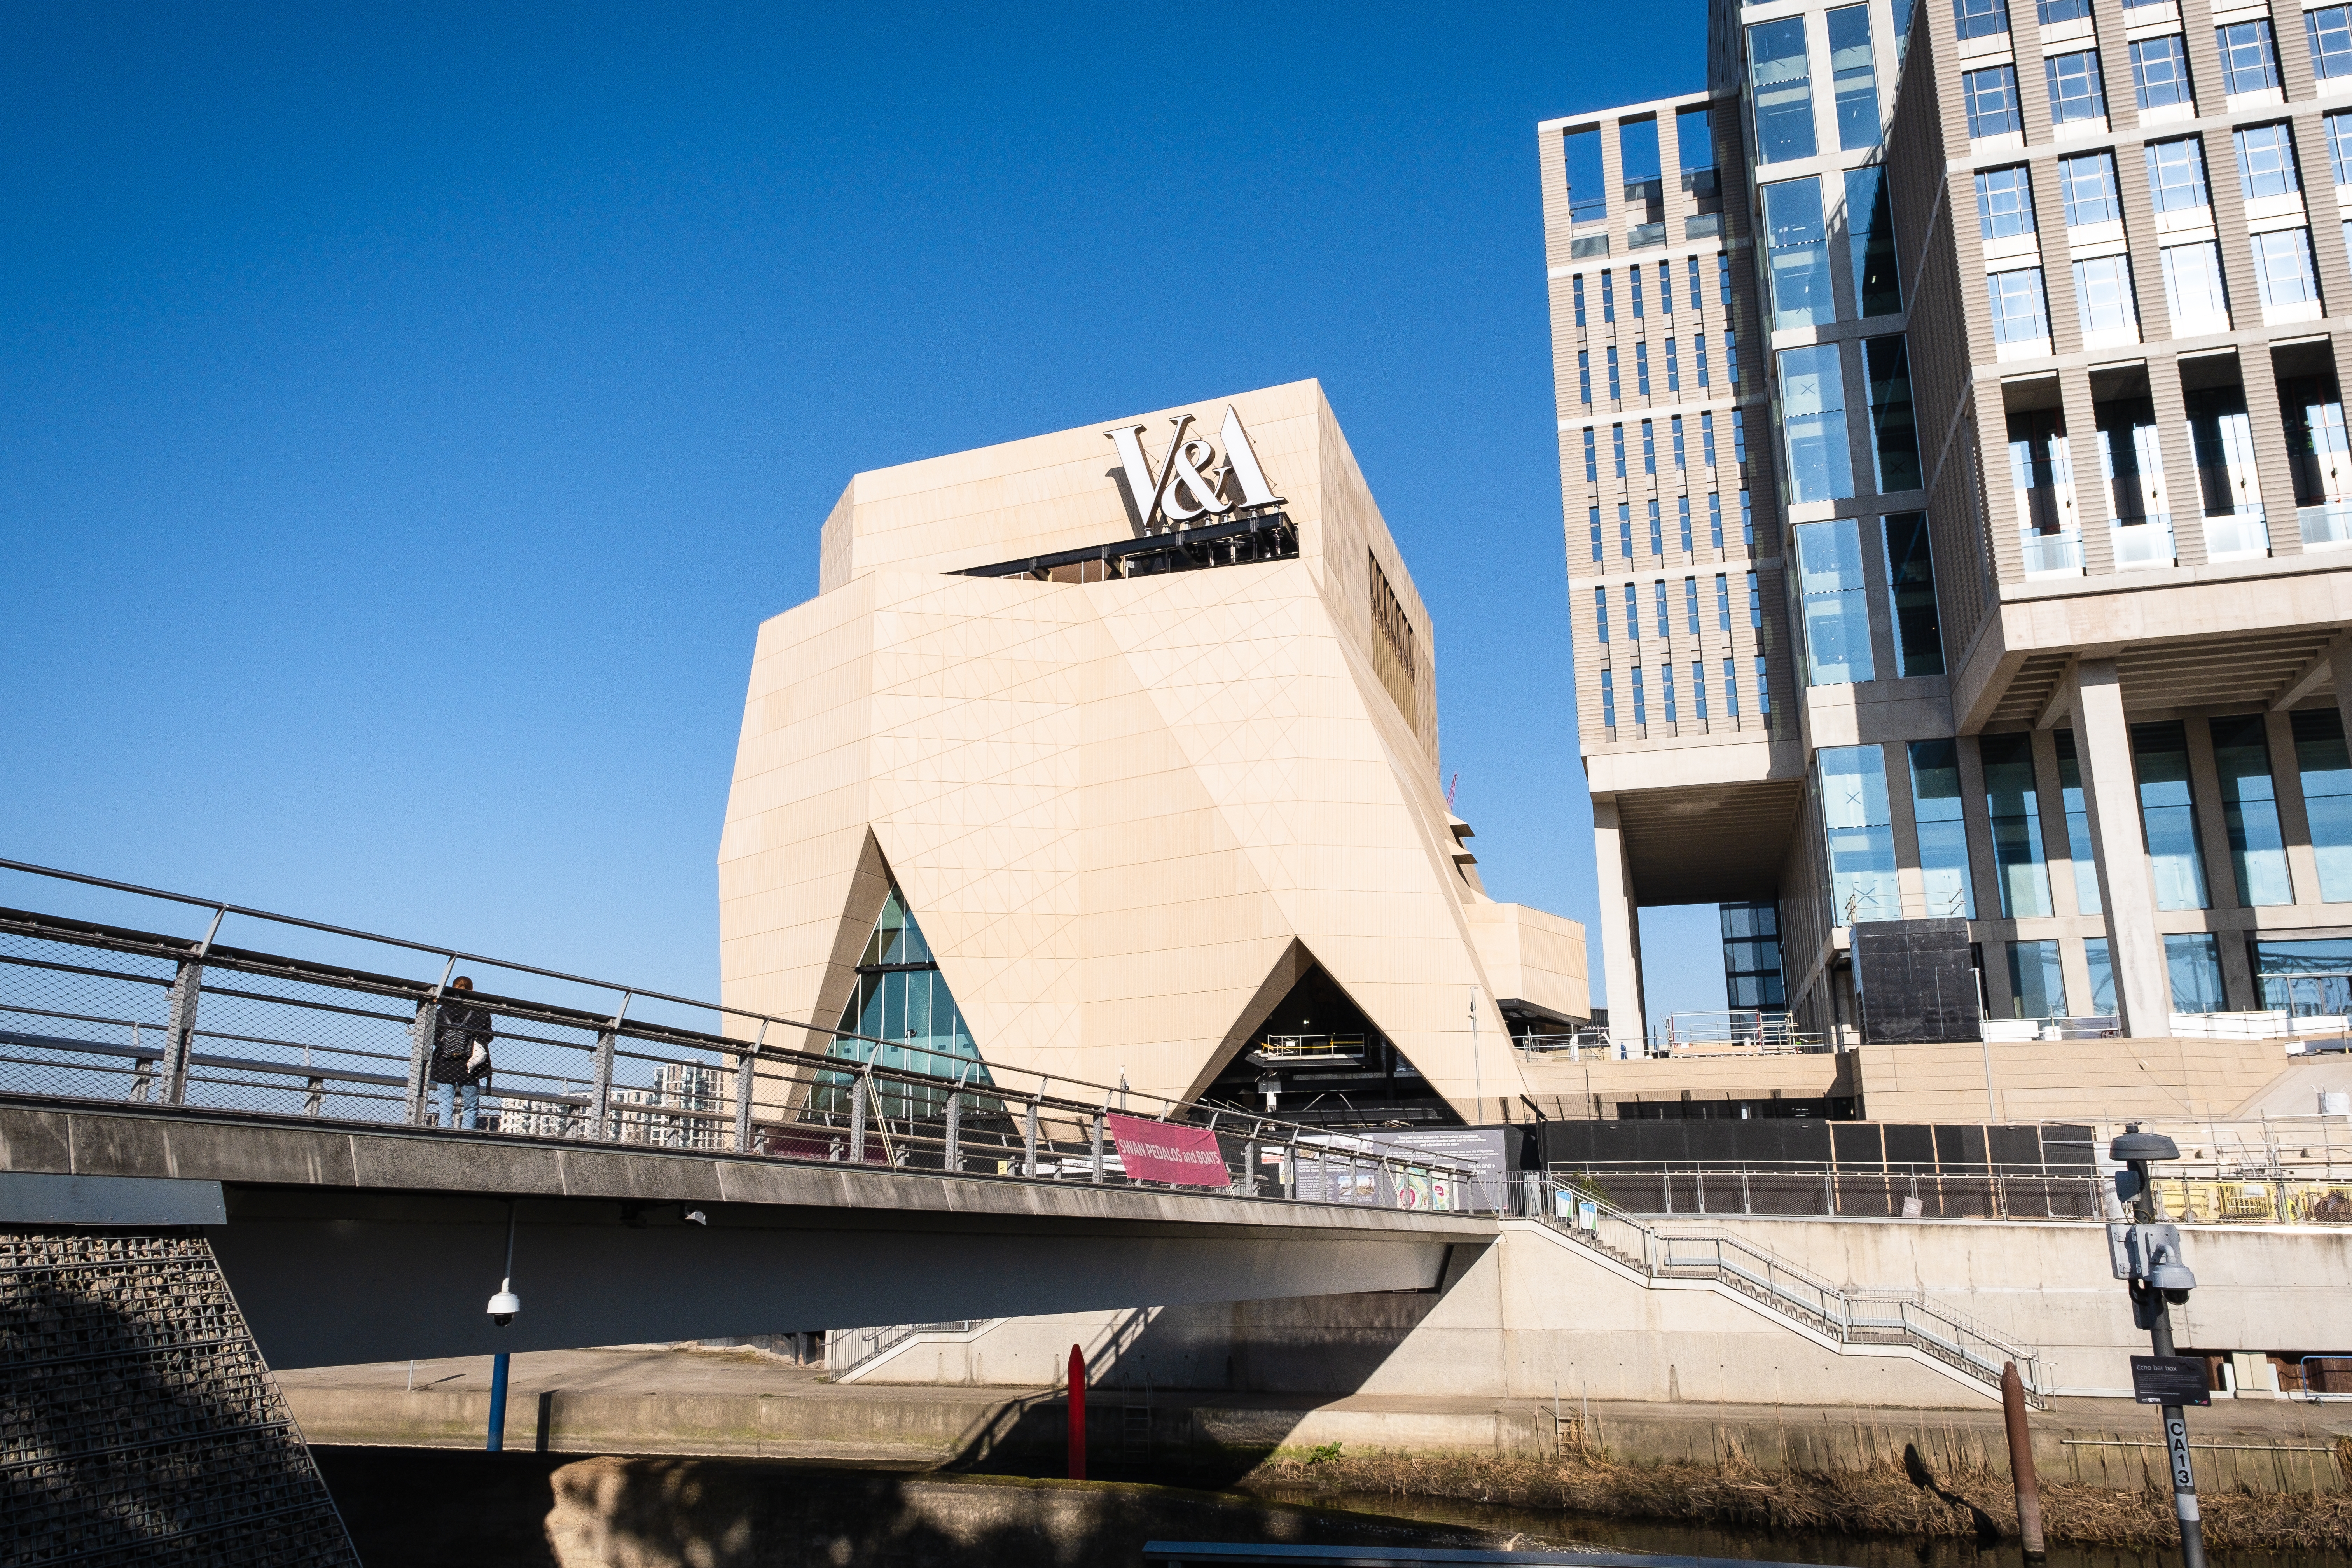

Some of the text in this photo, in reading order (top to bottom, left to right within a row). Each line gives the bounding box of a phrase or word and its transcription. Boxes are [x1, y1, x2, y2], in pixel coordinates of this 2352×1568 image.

[1103, 404, 1288, 527] V&A
[1118, 1138, 1220, 1164] SWAN PEDALOS and BOATS
[2170, 1422, 2189, 1484] CA13
